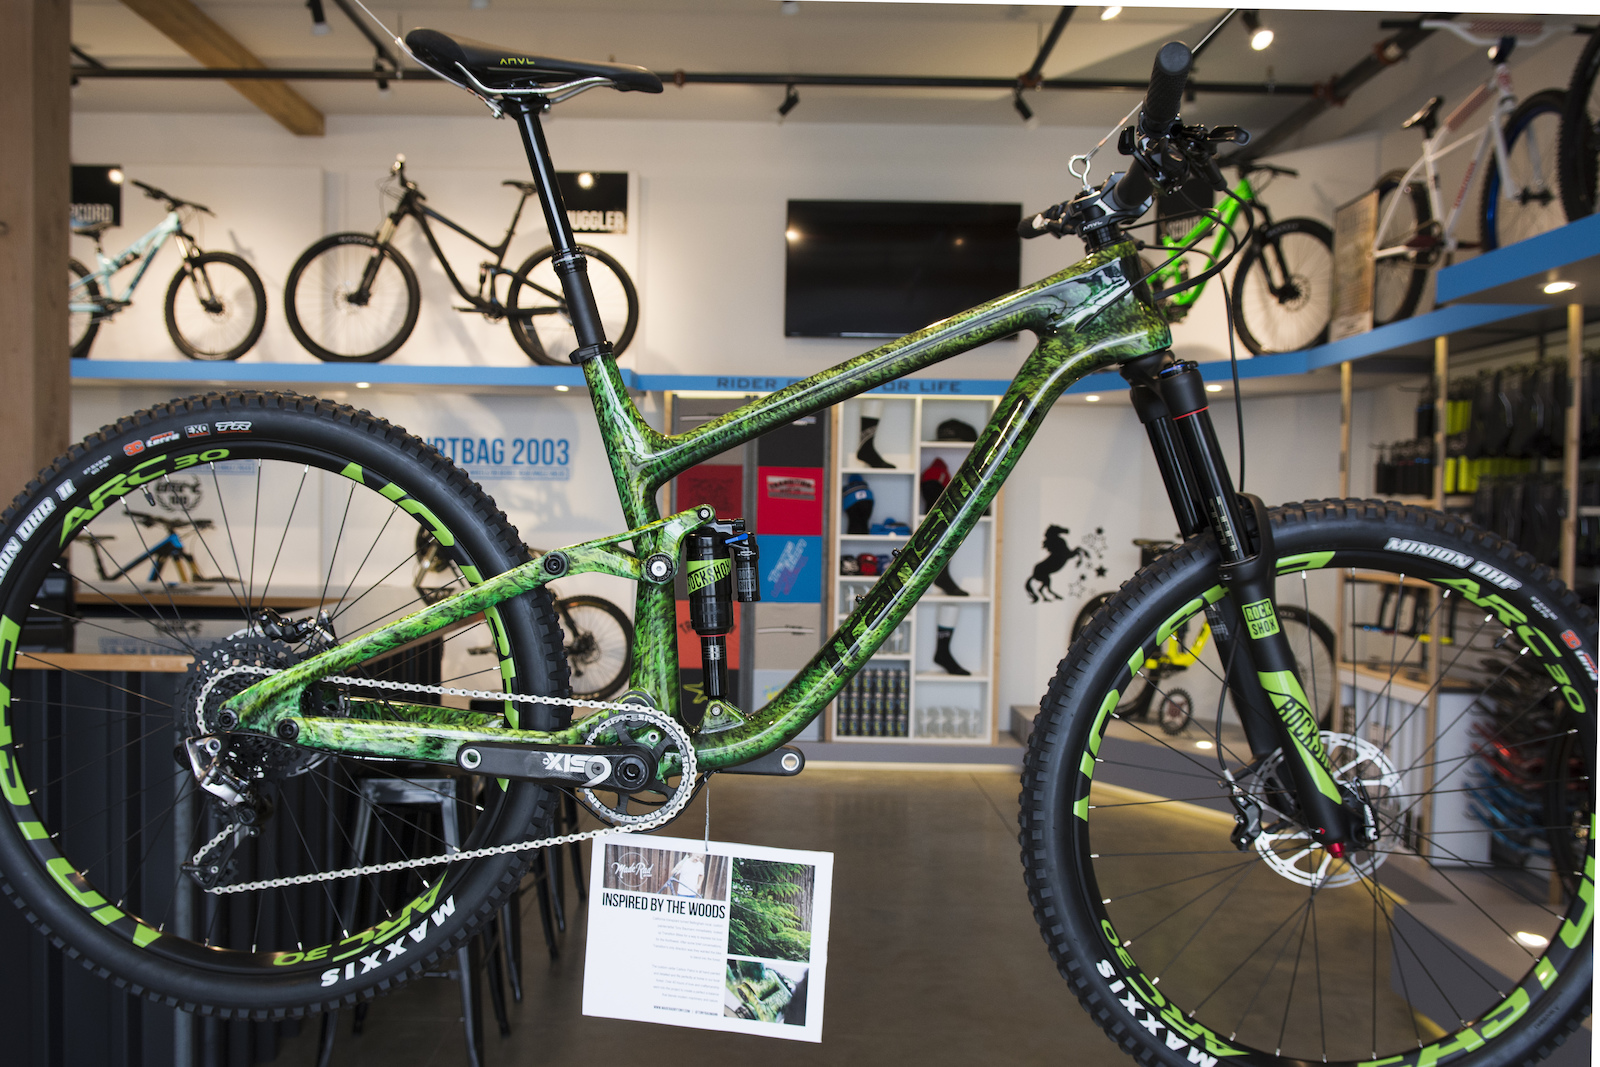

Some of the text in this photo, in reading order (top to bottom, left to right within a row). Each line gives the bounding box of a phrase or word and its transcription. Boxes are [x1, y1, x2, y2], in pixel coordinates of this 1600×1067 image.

[716, 377, 777, 390] RIDER
[882, 380, 910, 392] OR
[919, 380, 962, 393] LIFE
[512, 438, 570, 466] 2003
[59, 448, 230, 548] ARC 30
[1383, 537, 1474, 569] MINION
[1245, 601, 1273, 622] ROCK
[1251, 618, 1277, 636] SHOX
[1428, 577, 1586, 714] ARC 30
[611, 861, 654, 879] Made Rad
[273, 869, 448, 966] ARC 30
[602, 892, 726, 919] INSPIRED BY THE WOODS
[321, 895, 456, 987] MAXXIS
[1101, 919, 1250, 1057] ARC 30
[1096, 959, 1219, 1067] MAXXIS
